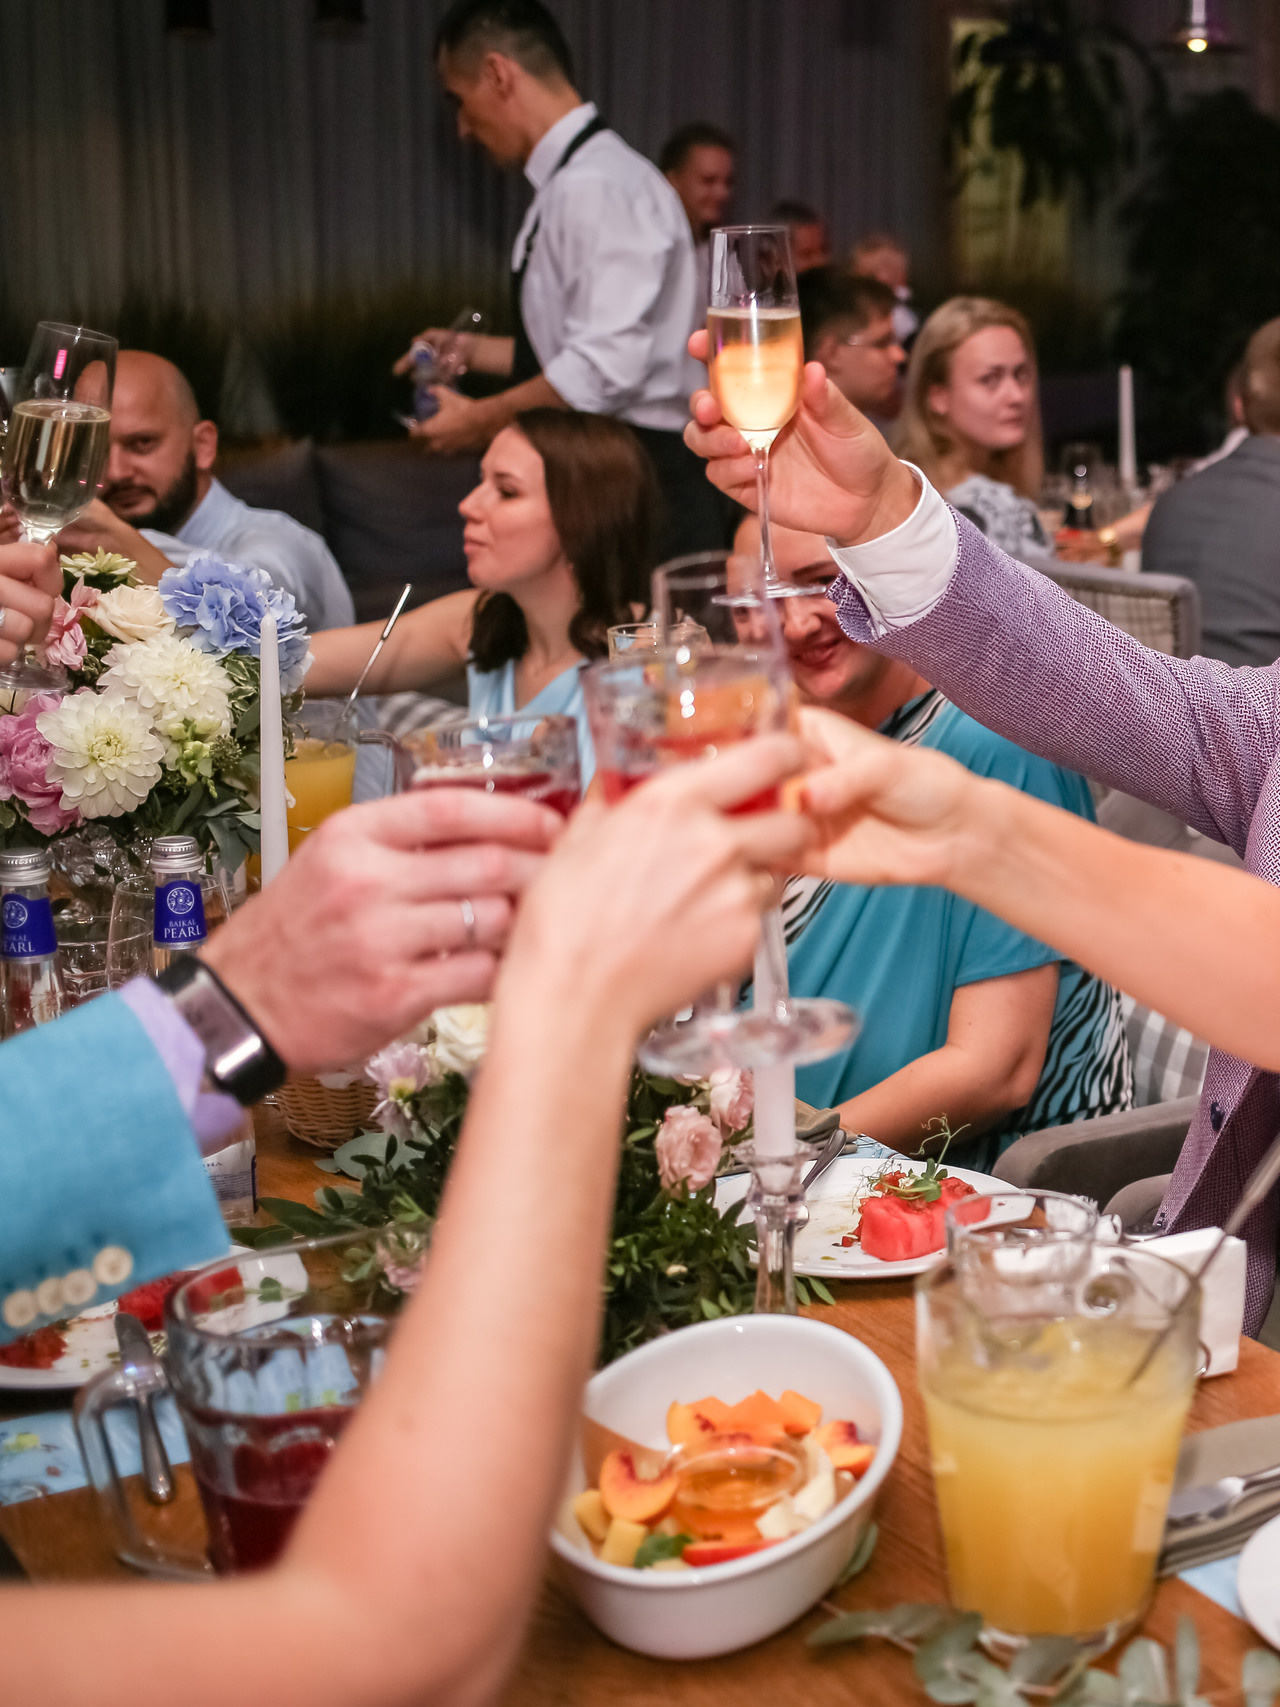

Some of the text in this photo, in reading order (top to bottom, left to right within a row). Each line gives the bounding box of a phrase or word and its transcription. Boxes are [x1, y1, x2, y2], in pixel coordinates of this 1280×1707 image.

[169, 919, 196, 928] BAIKAL
[164, 925, 202, 939] PEARL
[3, 941, 36, 953] EARL
